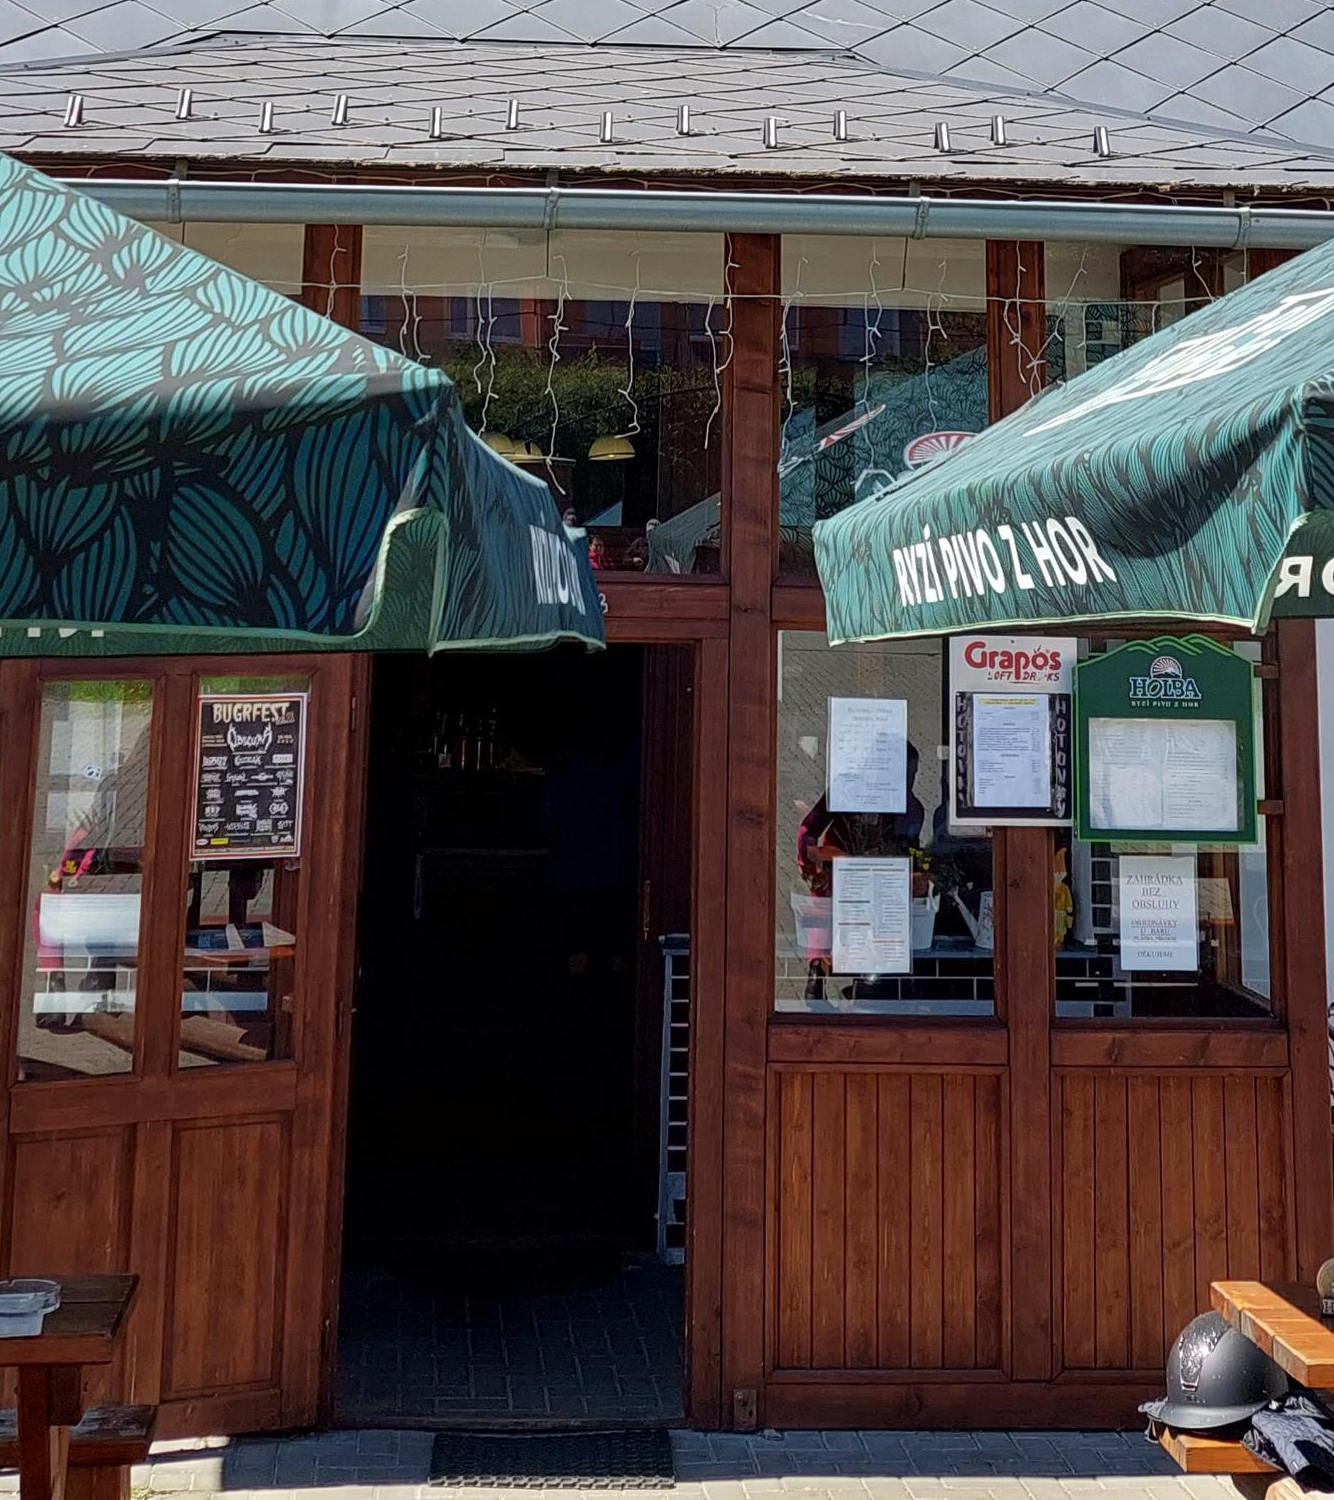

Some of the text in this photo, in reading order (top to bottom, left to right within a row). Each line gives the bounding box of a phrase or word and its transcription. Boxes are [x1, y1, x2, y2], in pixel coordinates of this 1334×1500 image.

[892, 516, 1117, 607] RYZÍ PIVO Z HOR
[1128, 676, 1202, 700] HOLBA
[212, 703, 290, 723] BUGRFEST
[1126, 873, 1183, 885] ZAHRÁDKA
[1142, 887, 1161, 897] BEZ
[1132, 900, 1179, 910] OBSLUHY
